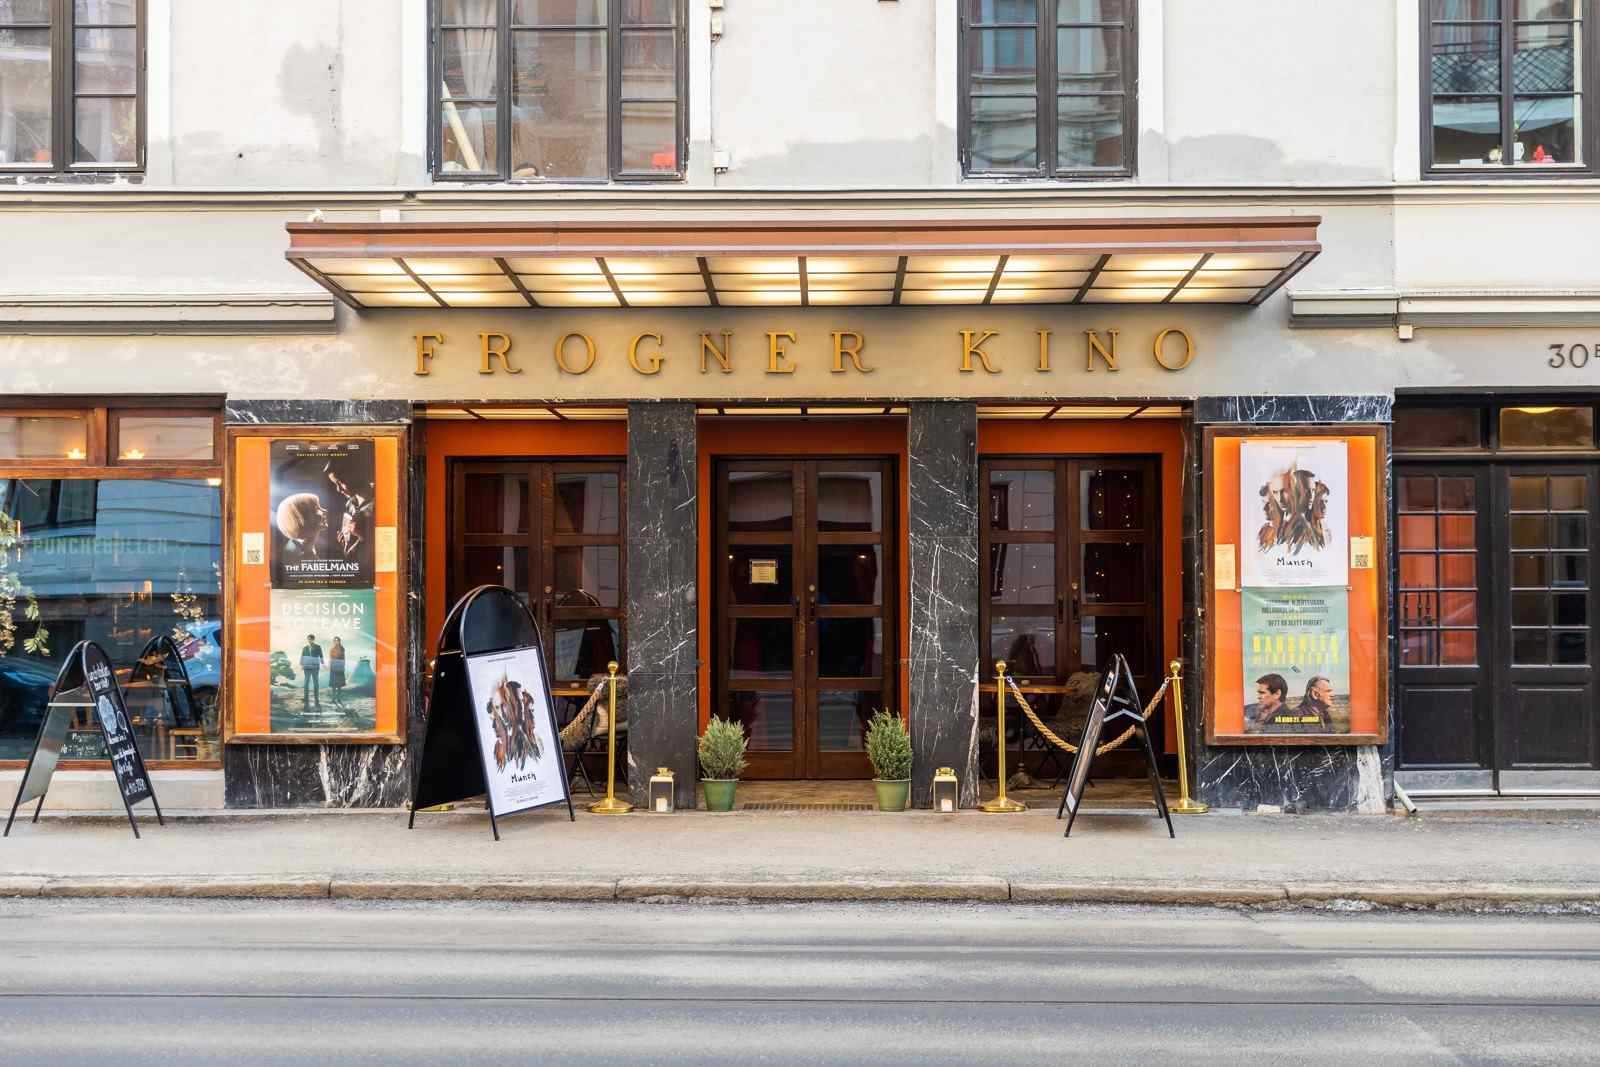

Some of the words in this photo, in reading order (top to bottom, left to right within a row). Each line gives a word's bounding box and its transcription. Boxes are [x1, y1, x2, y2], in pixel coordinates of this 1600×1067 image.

[413, 330, 874, 375] FROGNER
[959, 328, 1195, 373] KINO
[285, 564, 300, 572] THE
[301, 562, 360, 572] FABELMANS
[1276, 557, 1313, 568] Munch
[281, 602, 364, 615] DECISION
[511, 773, 537, 784] Munch
